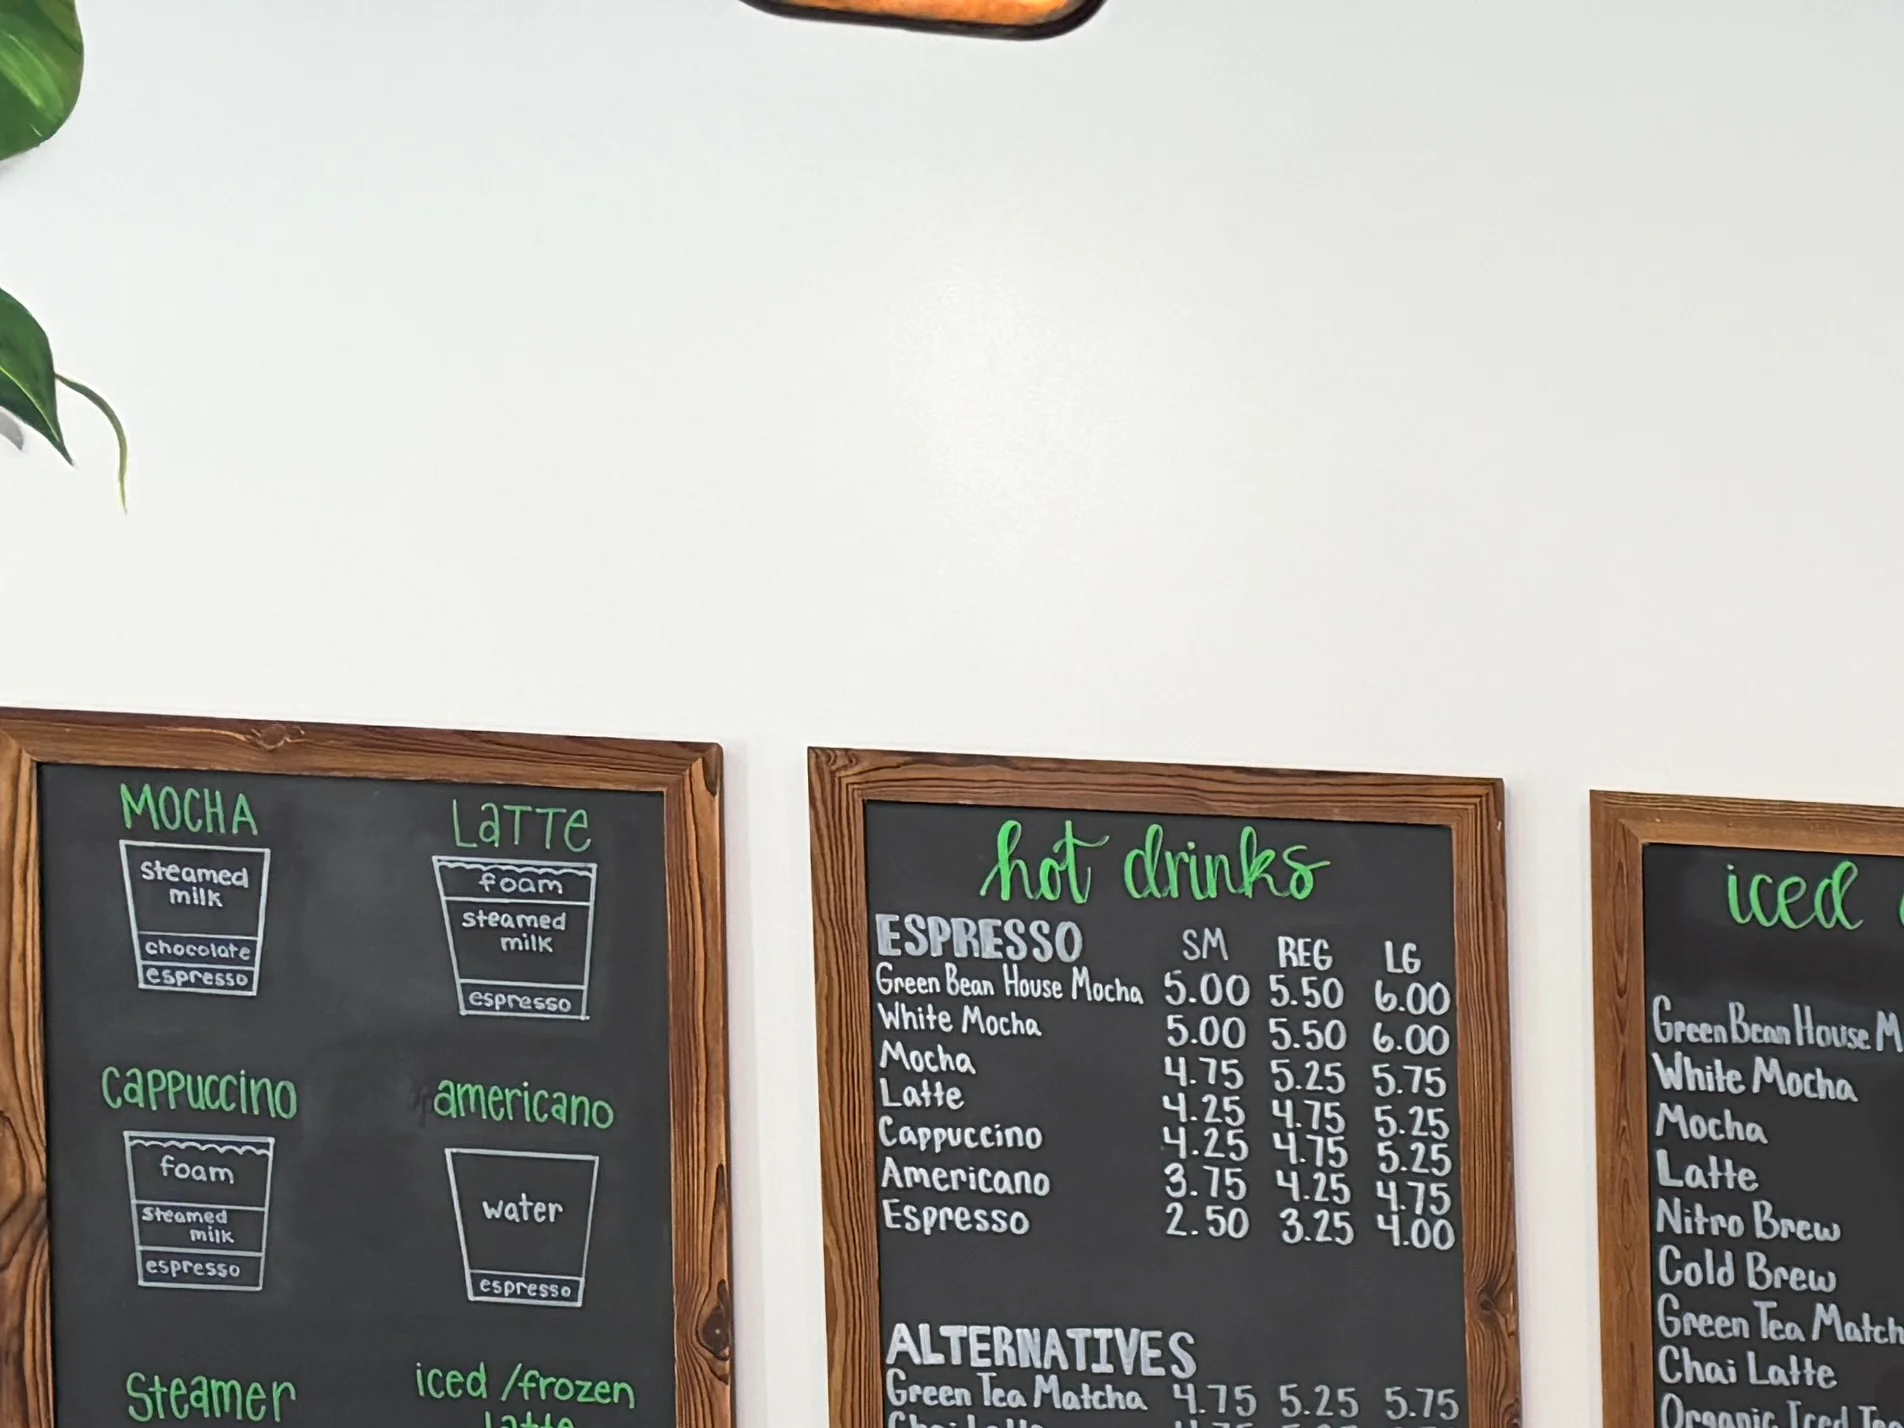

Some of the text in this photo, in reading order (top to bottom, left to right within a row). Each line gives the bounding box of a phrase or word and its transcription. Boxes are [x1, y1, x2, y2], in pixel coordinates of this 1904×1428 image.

[120, 783, 258, 836] MOCHA
[140, 859, 249, 889] steamed
[979, 819, 1331, 904] hot drinks
[169, 886, 223, 908] milk
[1727, 860, 1864, 930] iced
[145, 939, 251, 961] chocolate
[874, 913, 1421, 974] ESPRESSO SM REG LG
[145, 967, 249, 987] espresso
[875, 961, 1451, 1016] Green Bean House Mocha 5.00 5.50 6.00
[879, 1039, 1447, 1098] Mocha 4.75 5.25 5.75
[1651, 1050, 1746, 1095] White
[1751, 1055, 1859, 1102] Mocha
[433, 1079, 614, 1129] americano
[482, 1192, 564, 1223] water
[882, 1198, 1456, 1251] Espresso 2.50 3.25 4.00
[1656, 1196, 1745, 1238] Nitro
[1752, 1199, 1841, 1242] Brew
[479, 1278, 572, 1298] espresso
[885, 1322, 1197, 1379] ALTERNATIVES
